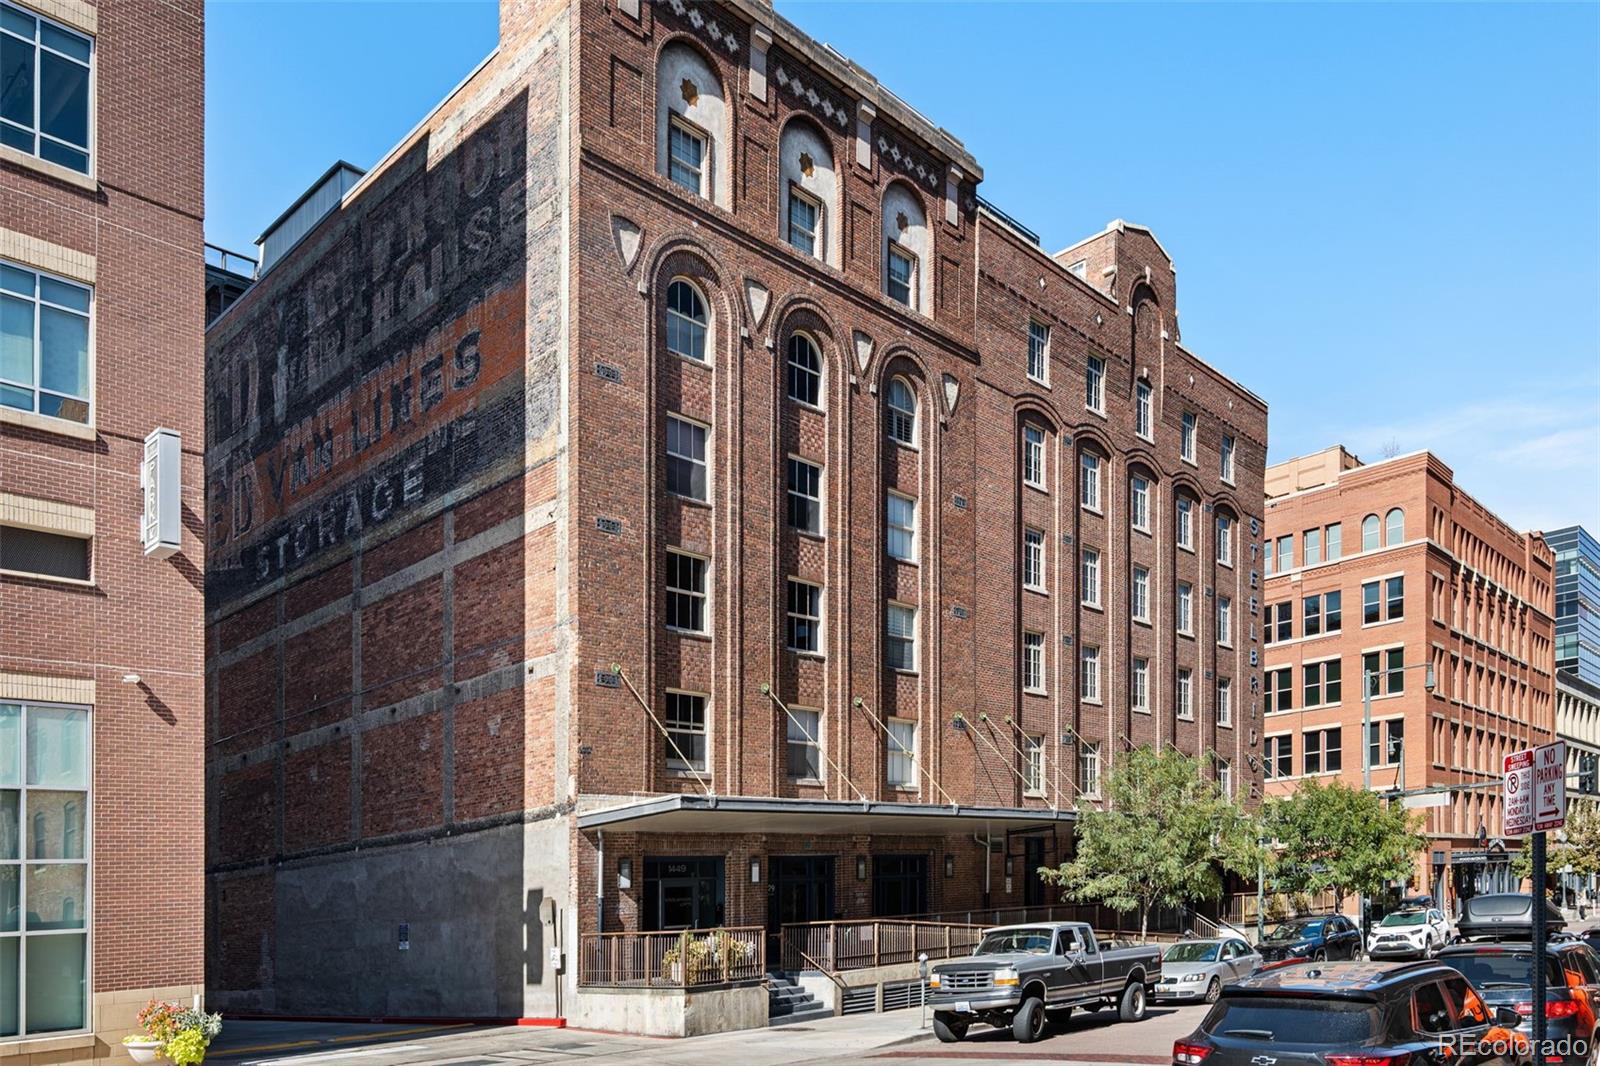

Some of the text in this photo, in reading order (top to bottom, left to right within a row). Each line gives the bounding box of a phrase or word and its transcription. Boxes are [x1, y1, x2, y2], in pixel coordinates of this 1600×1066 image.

[255, 454, 424, 582] STORAGE
[1510, 752, 1527, 763] STREET
[1544, 748, 1556, 765] NO
[1508, 760, 1530, 771] SWEEPING
[1537, 764, 1562, 784] PARKING
[1544, 782, 1555, 794] ANY
[1544, 794, 1556, 807] TIME
[1507, 805, 1525, 816] MONDAY
[1506, 815, 1531, 827] WEDNESDAY
